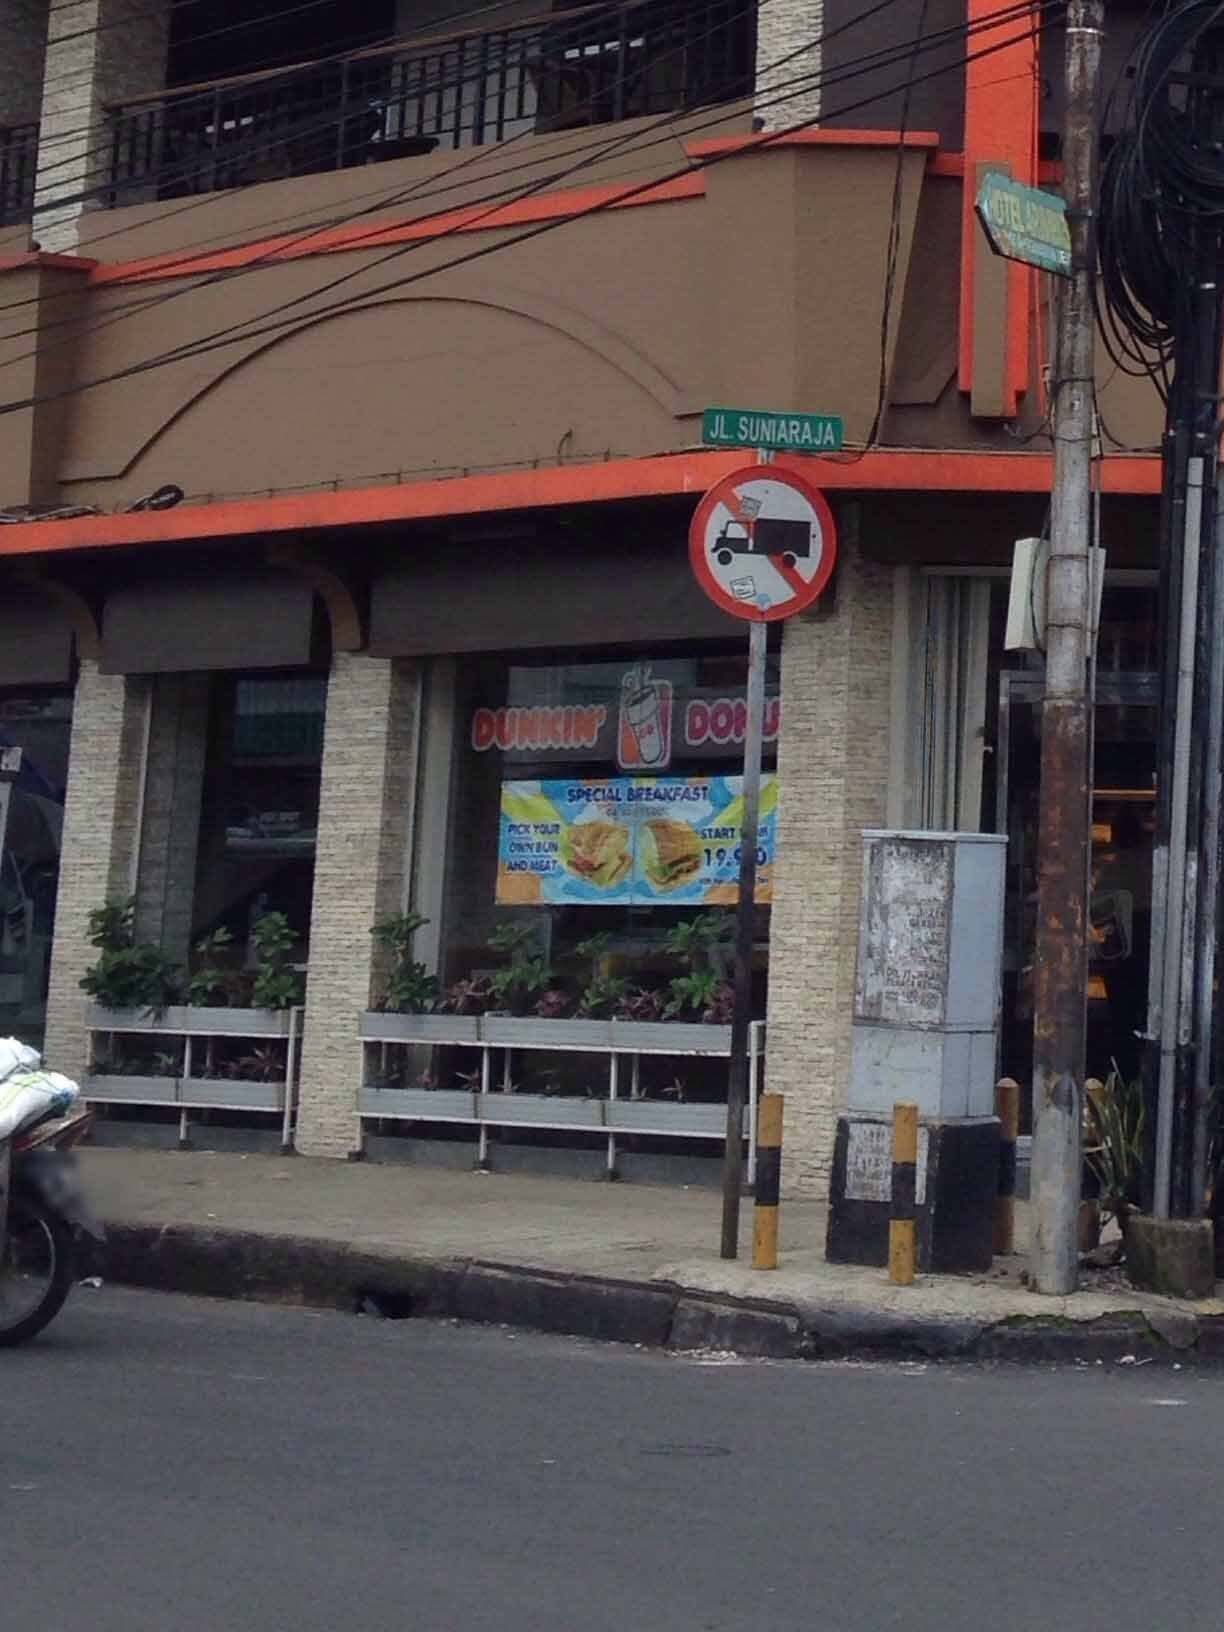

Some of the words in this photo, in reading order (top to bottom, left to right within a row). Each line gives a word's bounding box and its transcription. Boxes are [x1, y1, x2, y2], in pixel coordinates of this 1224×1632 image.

[738, 416, 835, 446] SUNIARAJA
[688, 700, 780, 742] DONU
[567, 787, 623, 804] SPECIAL
[626, 786, 709, 803] BREAKFAST
[508, 823, 531, 834] PICK
[533, 823, 560, 834] YOUR
[701, 827, 735, 840] START
[507, 859, 528, 871] AND
[530, 859, 558, 871] MEAT
[704, 847, 767, 866] 19.90
